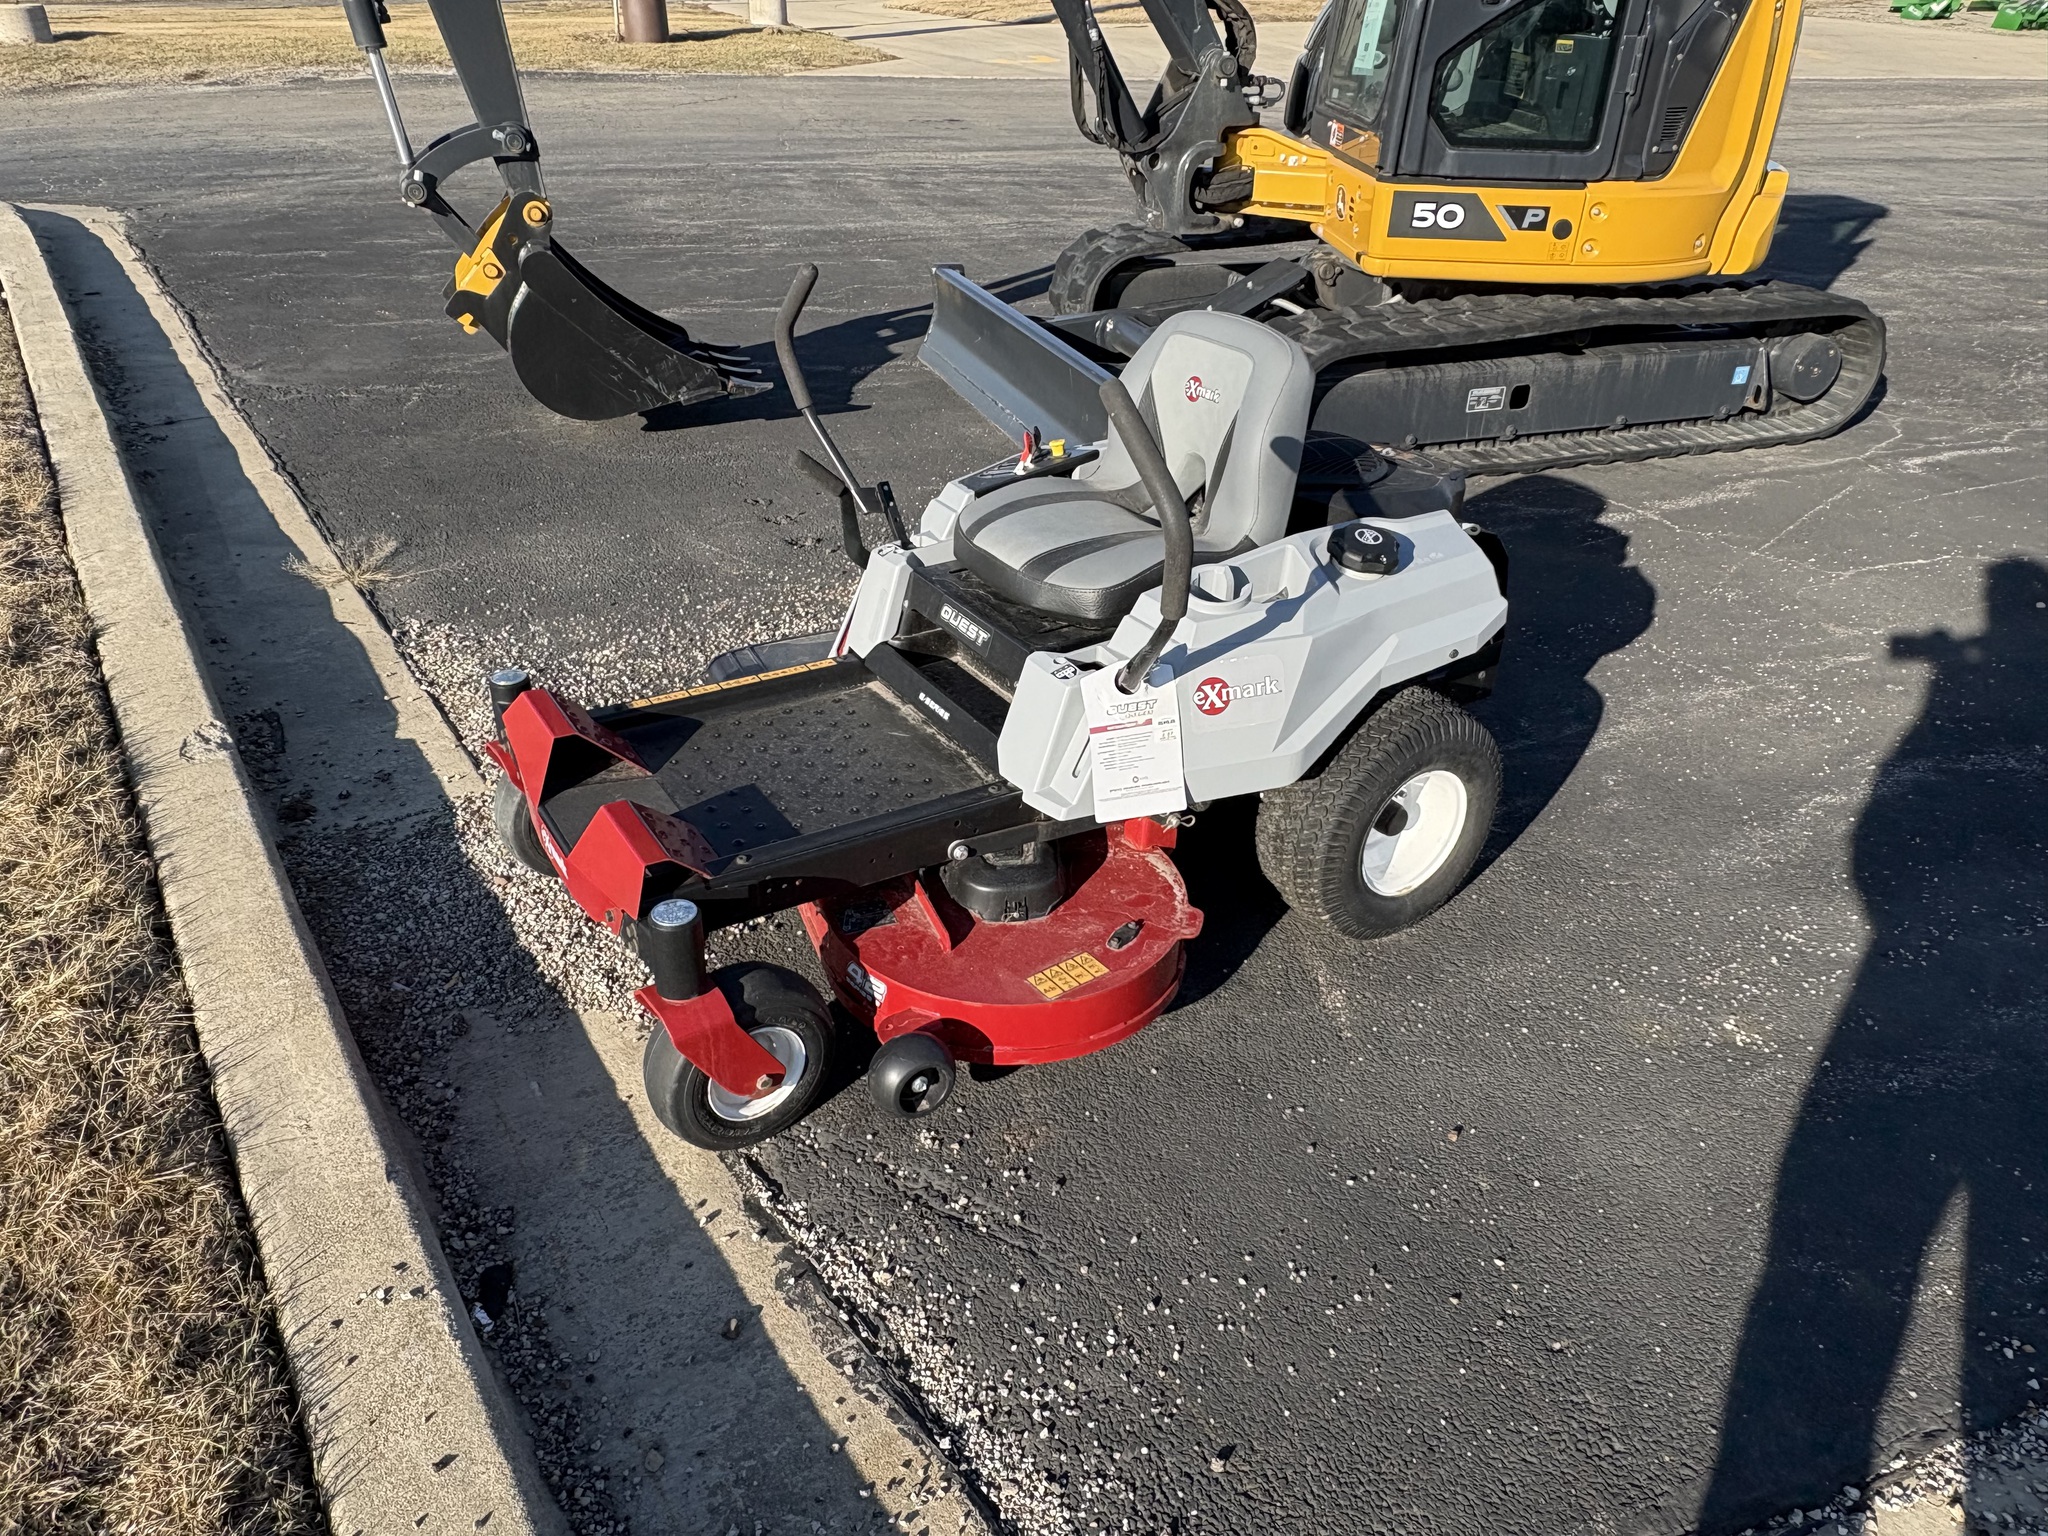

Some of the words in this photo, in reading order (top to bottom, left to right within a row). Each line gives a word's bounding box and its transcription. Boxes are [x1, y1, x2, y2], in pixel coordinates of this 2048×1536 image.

[1410, 201, 1466, 230] 50
[1521, 208, 1546, 228] P
[940, 603, 991, 647] QUEST
[1193, 676, 1282, 711] eXmark
